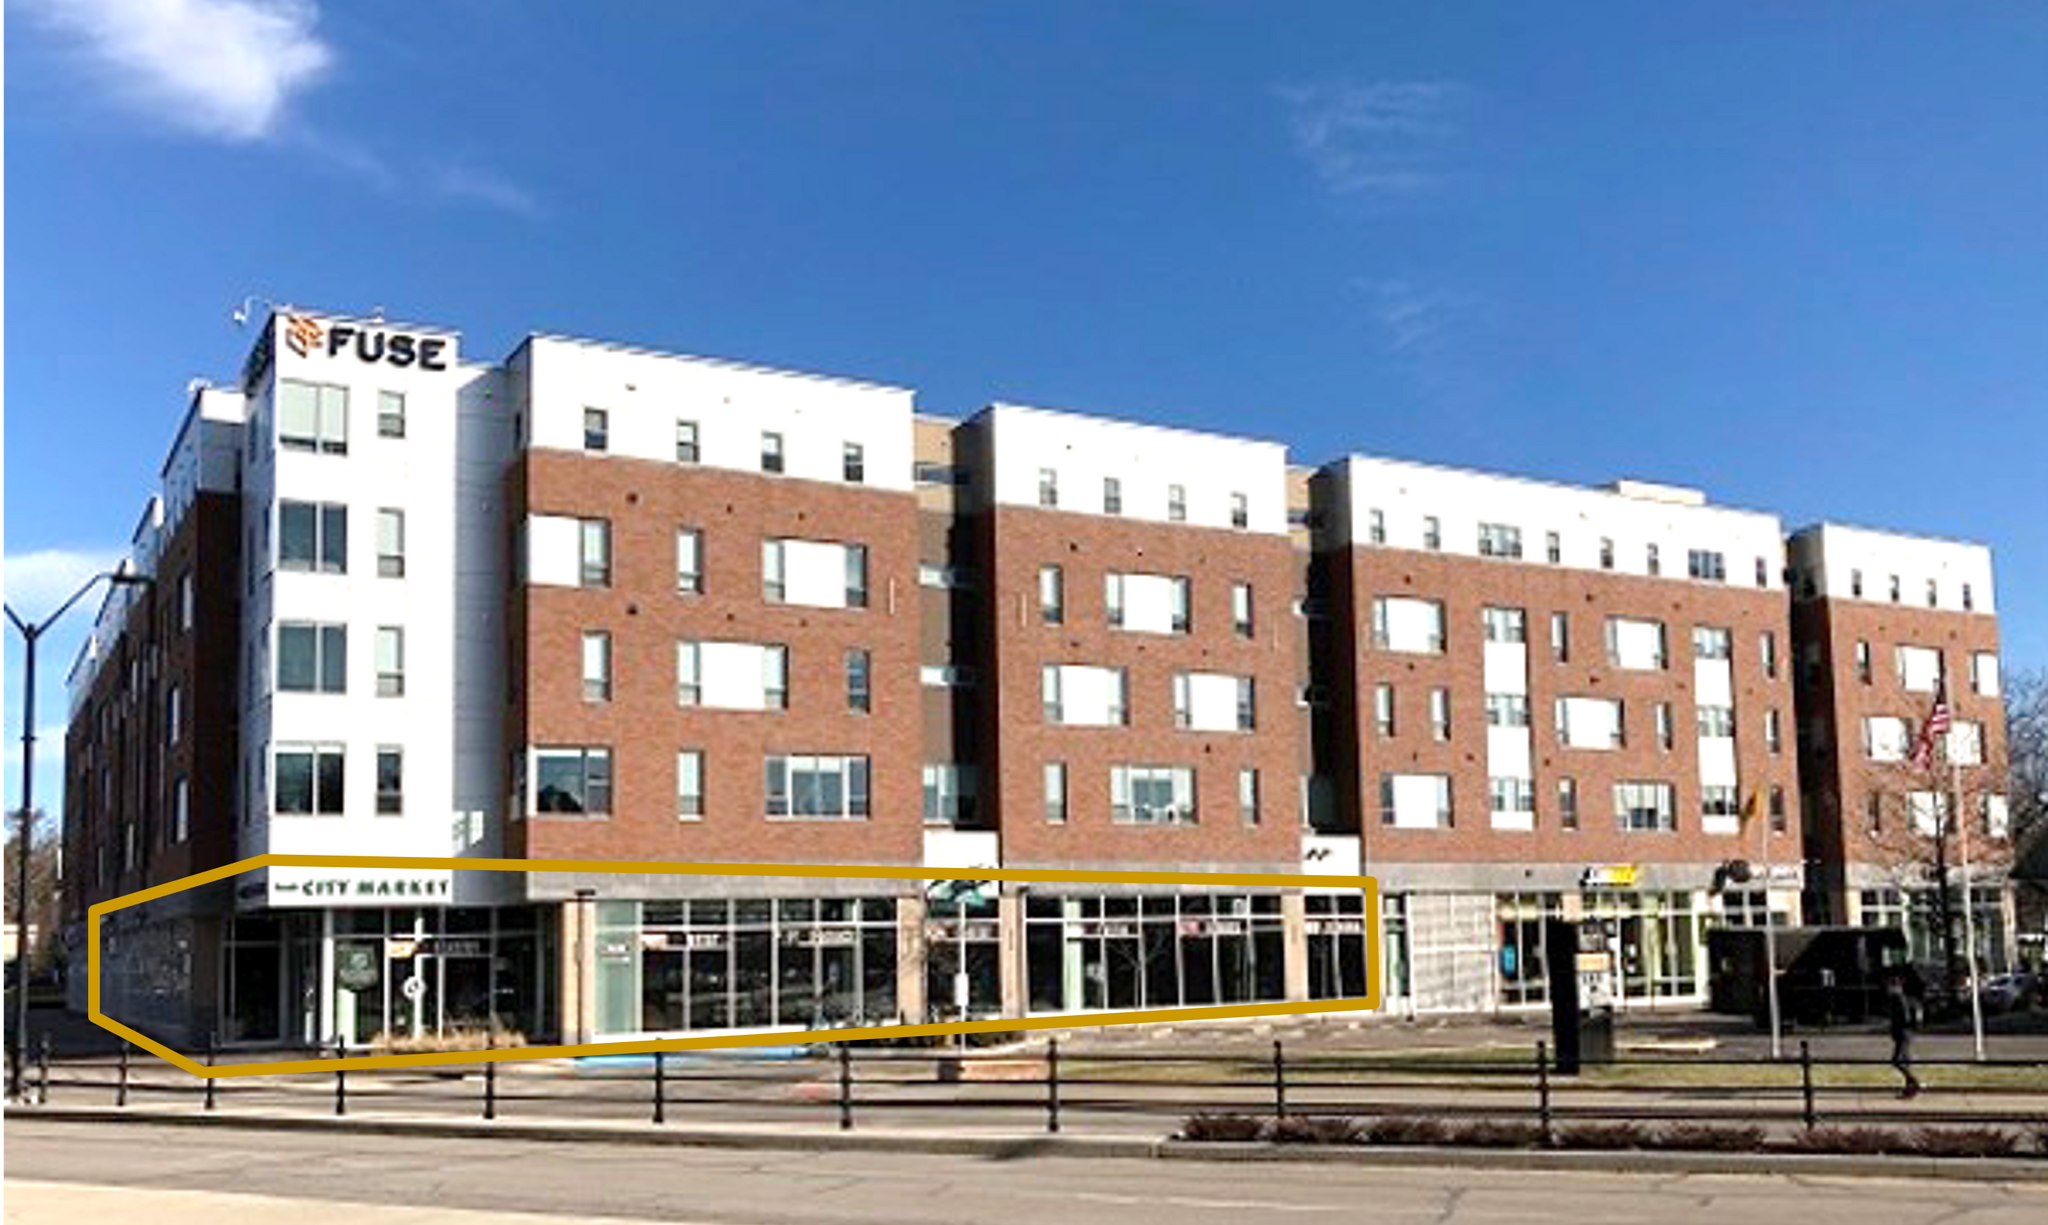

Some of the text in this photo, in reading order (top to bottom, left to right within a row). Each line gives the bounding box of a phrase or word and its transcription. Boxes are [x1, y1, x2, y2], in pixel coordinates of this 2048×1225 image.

[328, 328, 446, 371] FUSE
[302, 879, 350, 896] CITY
[356, 880, 448, 896] MARKET
